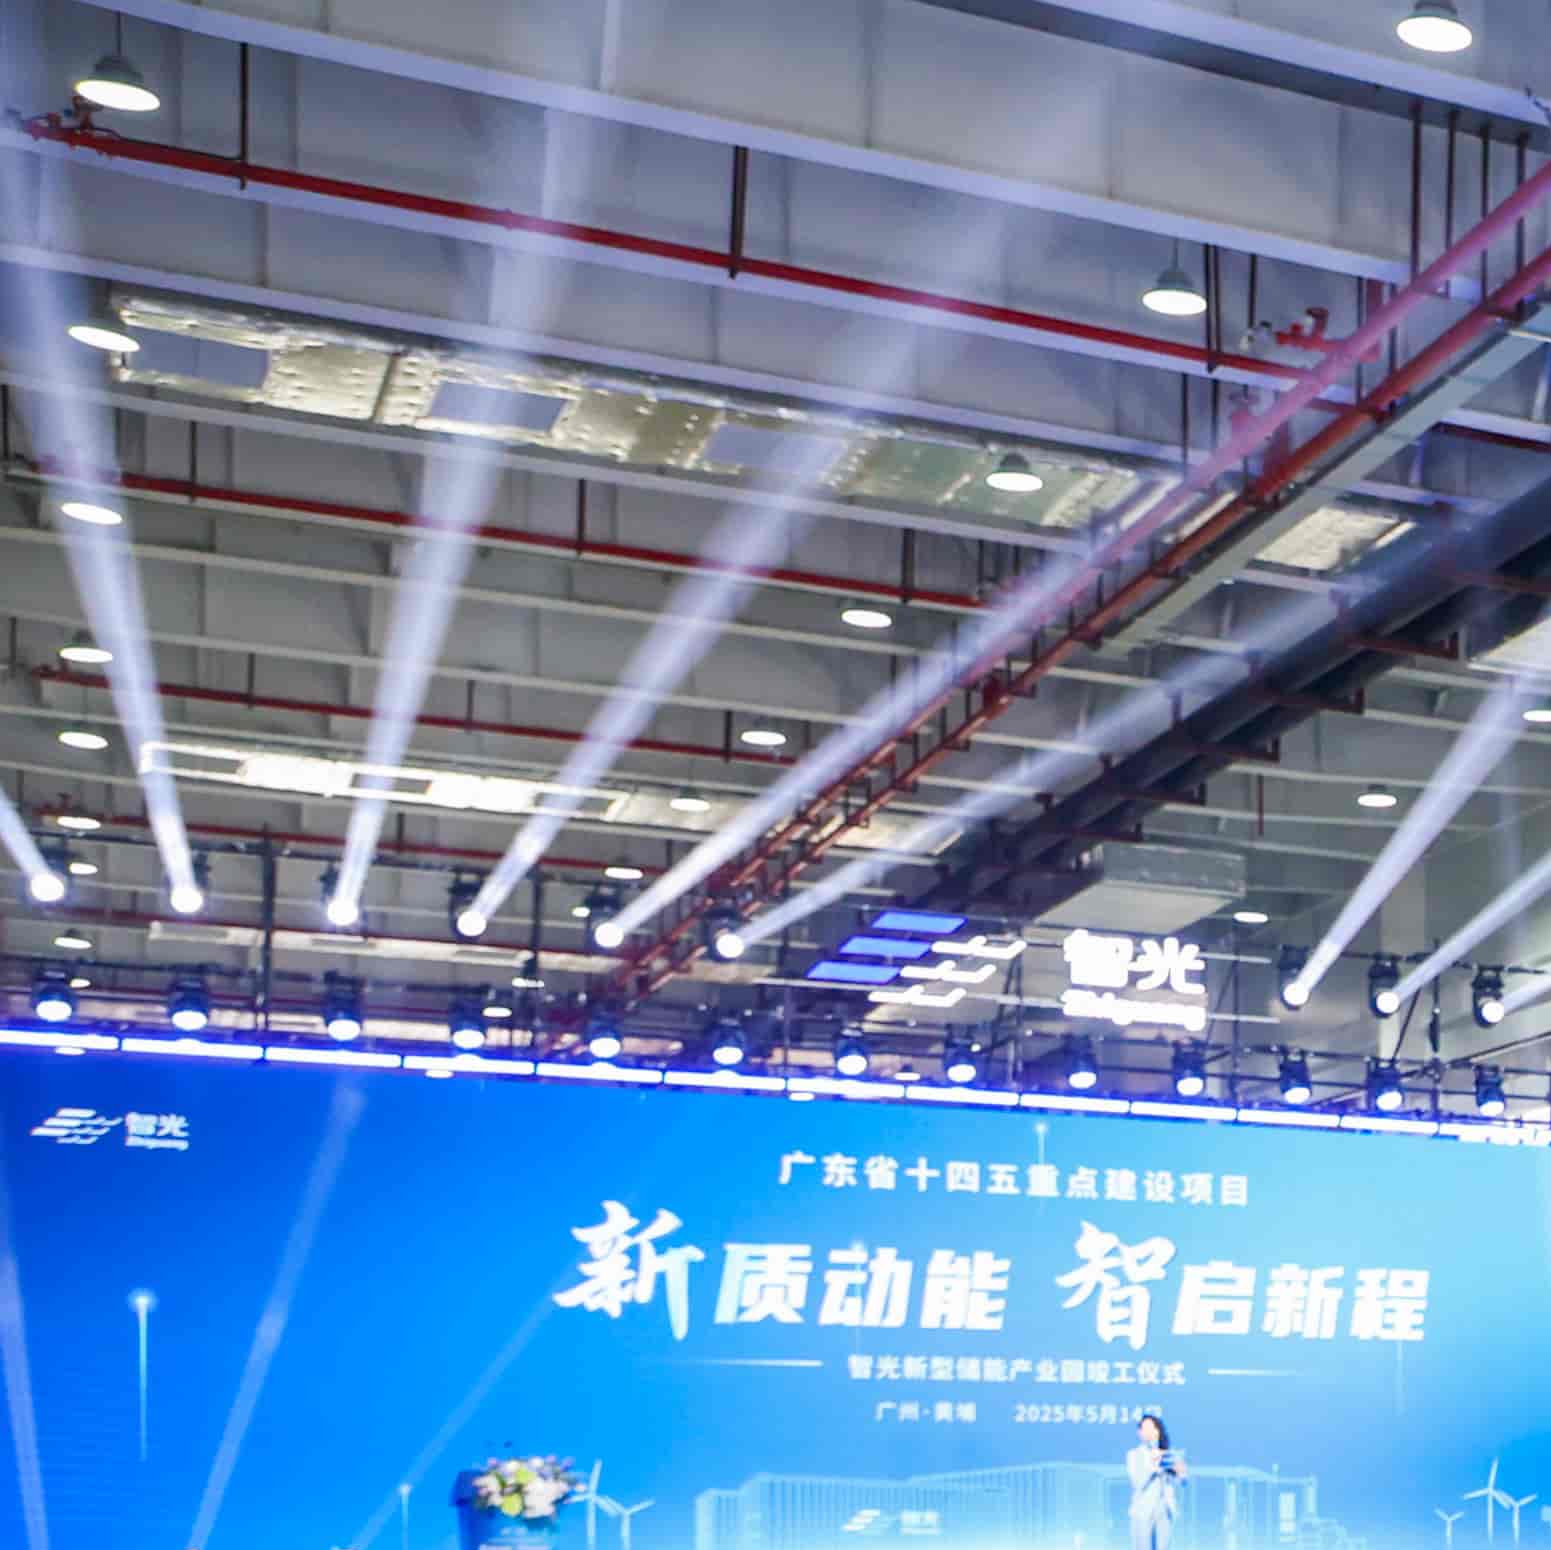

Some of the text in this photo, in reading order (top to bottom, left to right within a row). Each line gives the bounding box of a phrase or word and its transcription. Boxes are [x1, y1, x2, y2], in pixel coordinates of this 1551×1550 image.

[779, 1150, 1249, 1206] 广东省十四五重点建设项目
[552, 1200, 1430, 1351] 新质动能 智启新程
